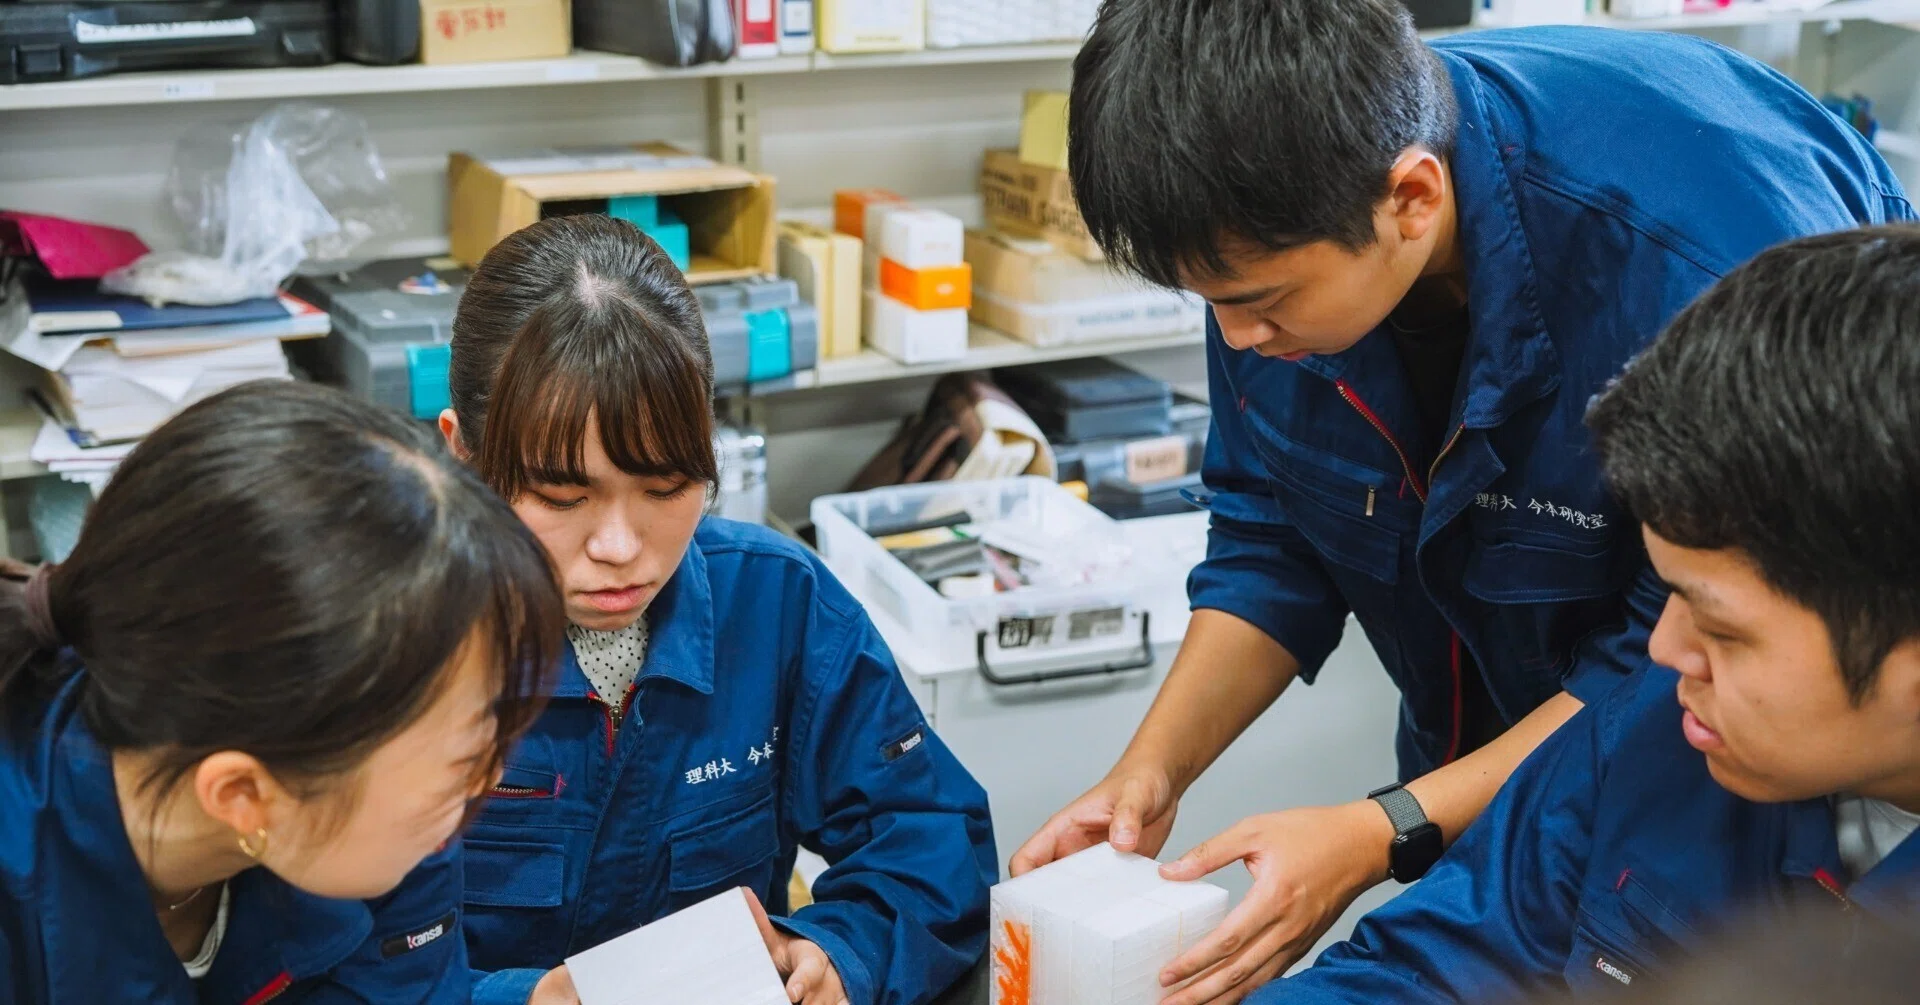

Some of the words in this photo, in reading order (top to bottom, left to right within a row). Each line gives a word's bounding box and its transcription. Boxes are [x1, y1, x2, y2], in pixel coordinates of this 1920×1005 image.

[1475, 493, 1517, 512] 理科大
[1527, 497, 1608, 529] 今本研究室
[684, 757, 737, 784] 理科大
